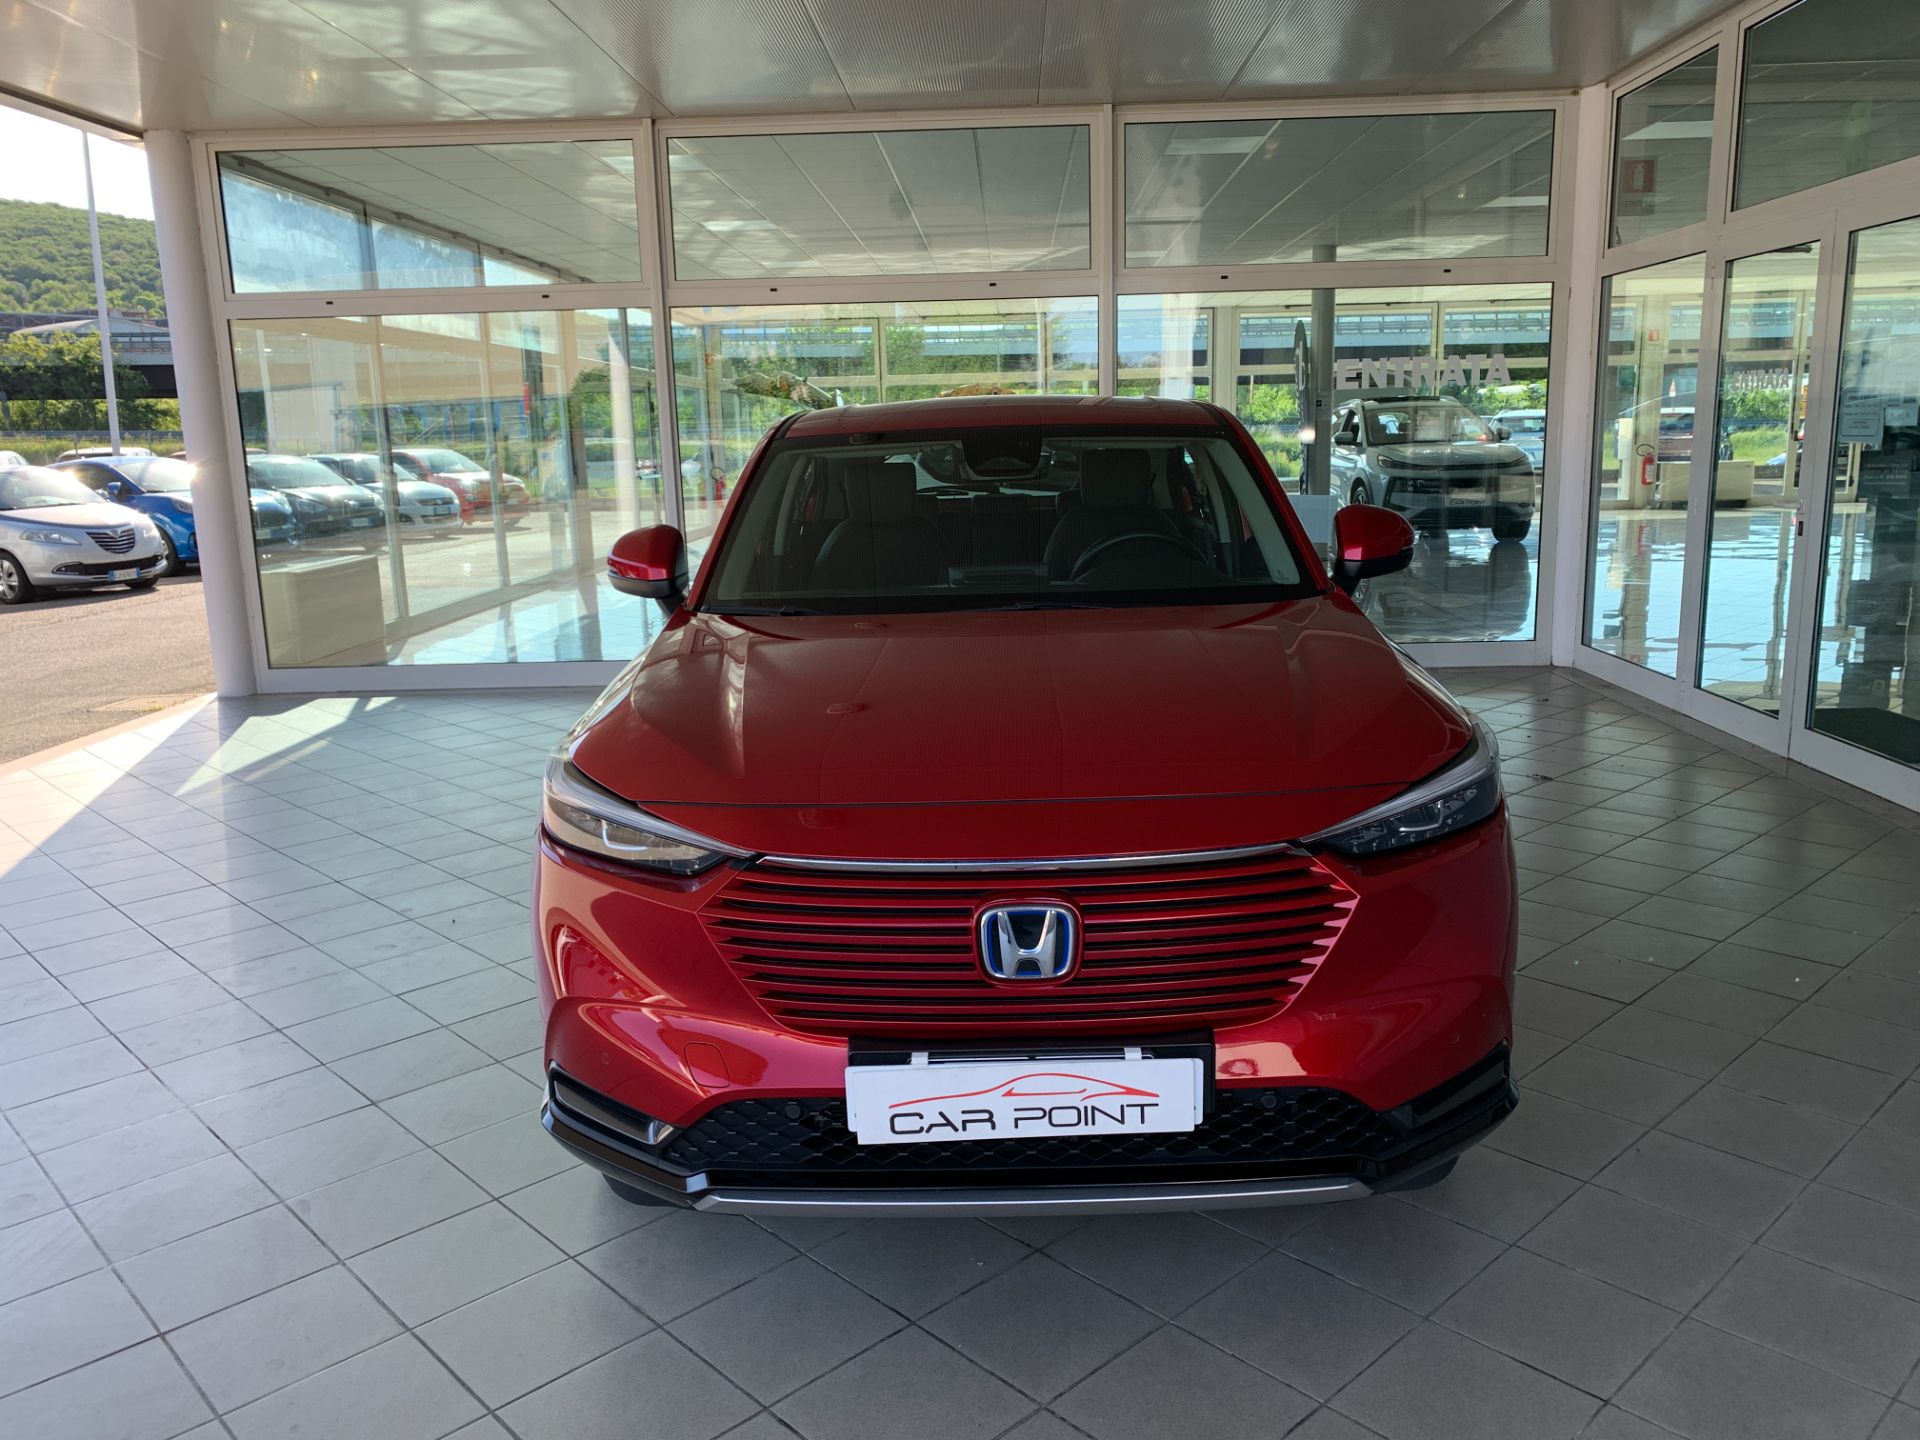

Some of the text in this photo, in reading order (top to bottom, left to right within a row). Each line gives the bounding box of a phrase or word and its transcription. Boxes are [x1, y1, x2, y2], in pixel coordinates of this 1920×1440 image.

[1335, 353, 1512, 390] ENTRATA
[888, 1102, 1159, 1136] CAR POINT
